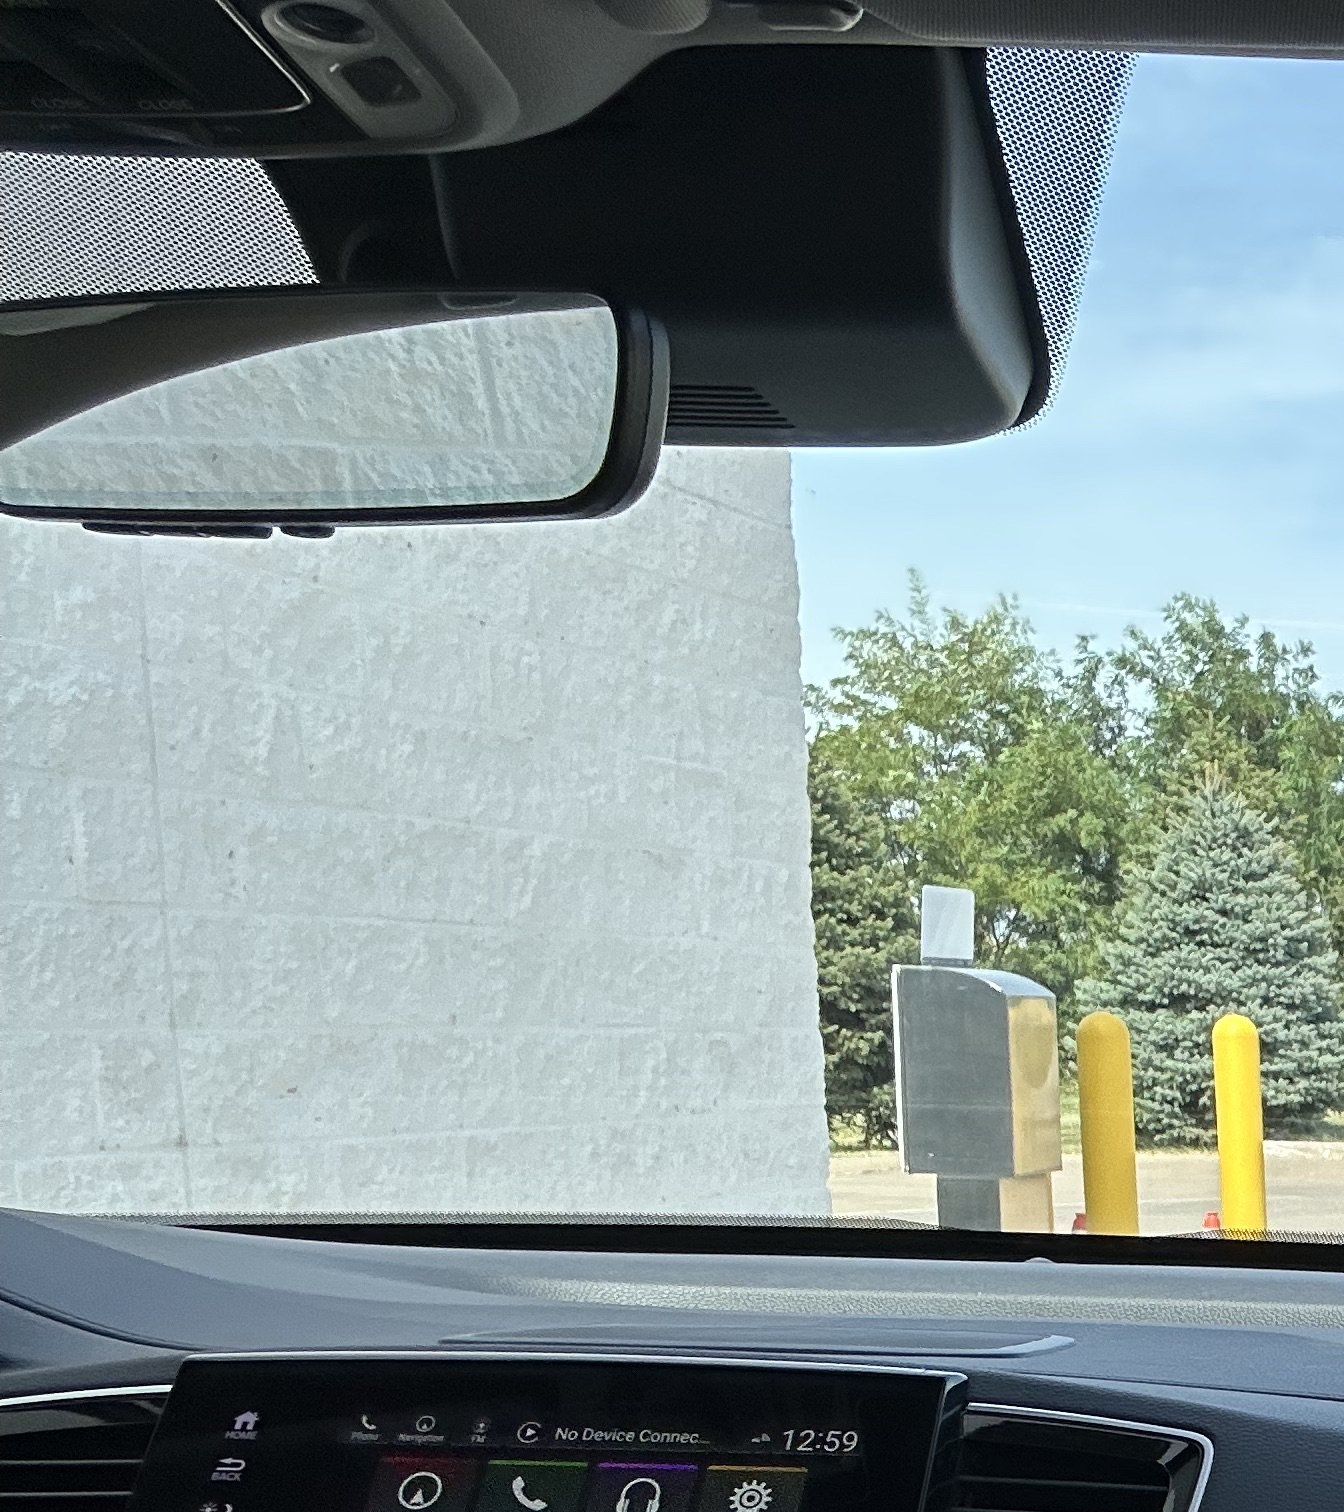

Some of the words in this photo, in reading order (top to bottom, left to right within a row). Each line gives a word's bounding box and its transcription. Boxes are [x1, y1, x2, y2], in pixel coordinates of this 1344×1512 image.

[224, 1430, 258, 1440] HOME
[555, 1427, 578, 1441] No
[582, 1428, 634, 1443] Device
[782, 1429, 858, 1452] 12:59
[211, 1472, 241, 1482] BACK
